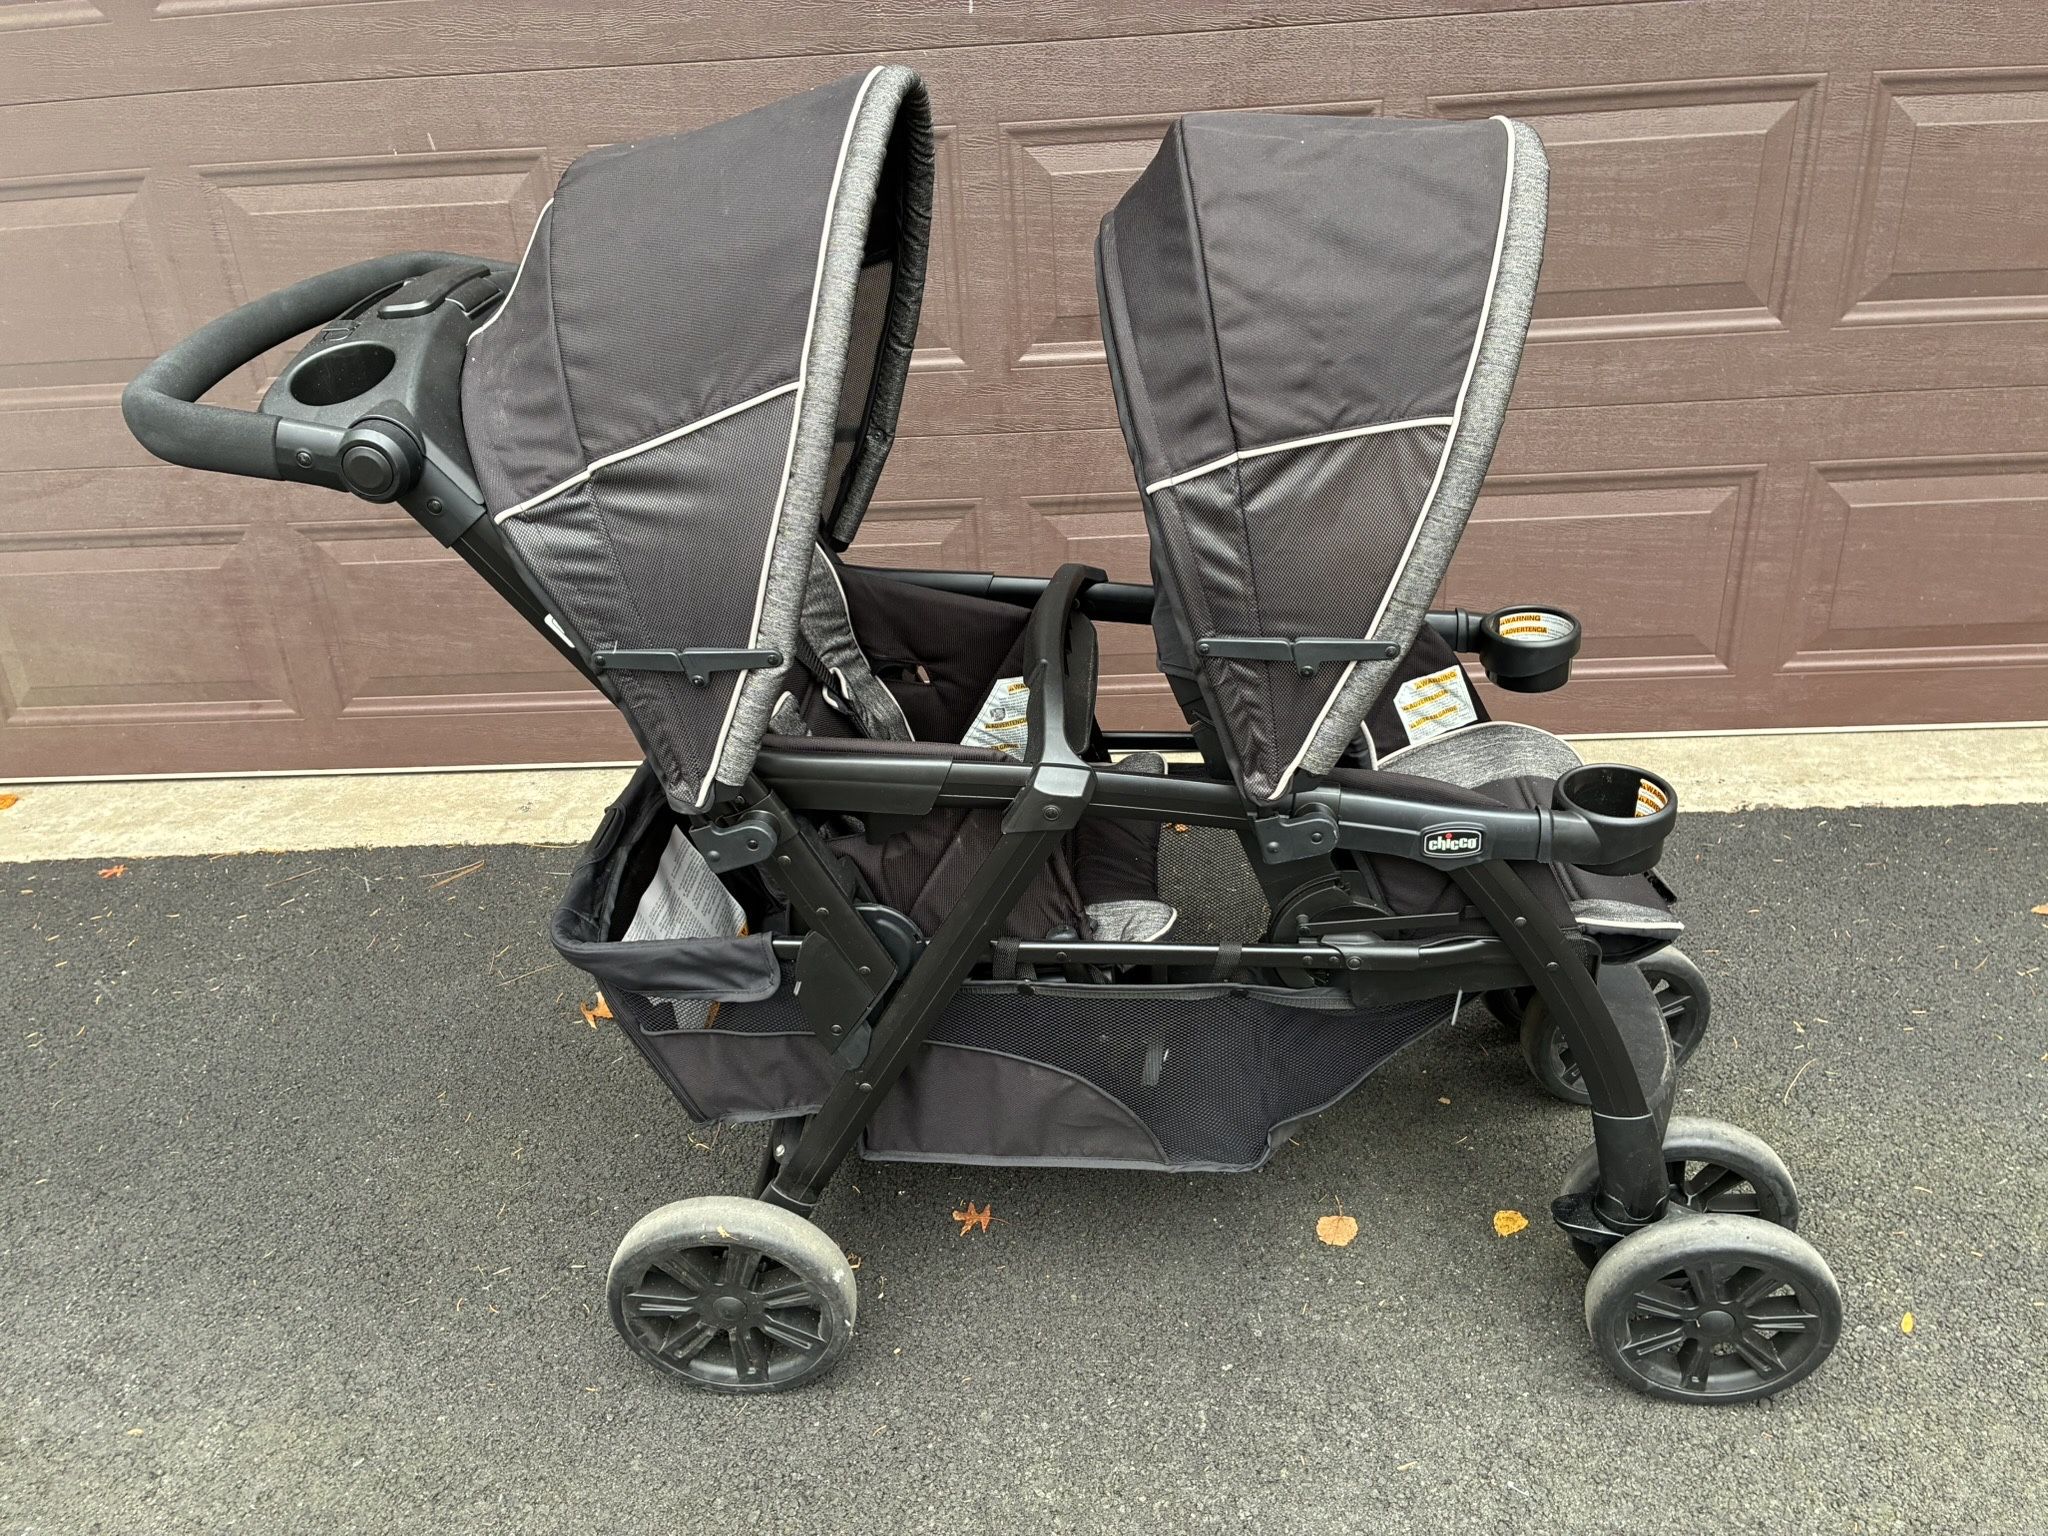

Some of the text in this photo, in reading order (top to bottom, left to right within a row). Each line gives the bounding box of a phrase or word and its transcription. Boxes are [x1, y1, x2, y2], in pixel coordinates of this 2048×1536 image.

[1504, 615, 1541, 625] WARNING
[1505, 626, 1547, 635] ADVERTENCIA
[1420, 672, 1457, 687] WARNING
[1428, 832, 1477, 851] chicco
